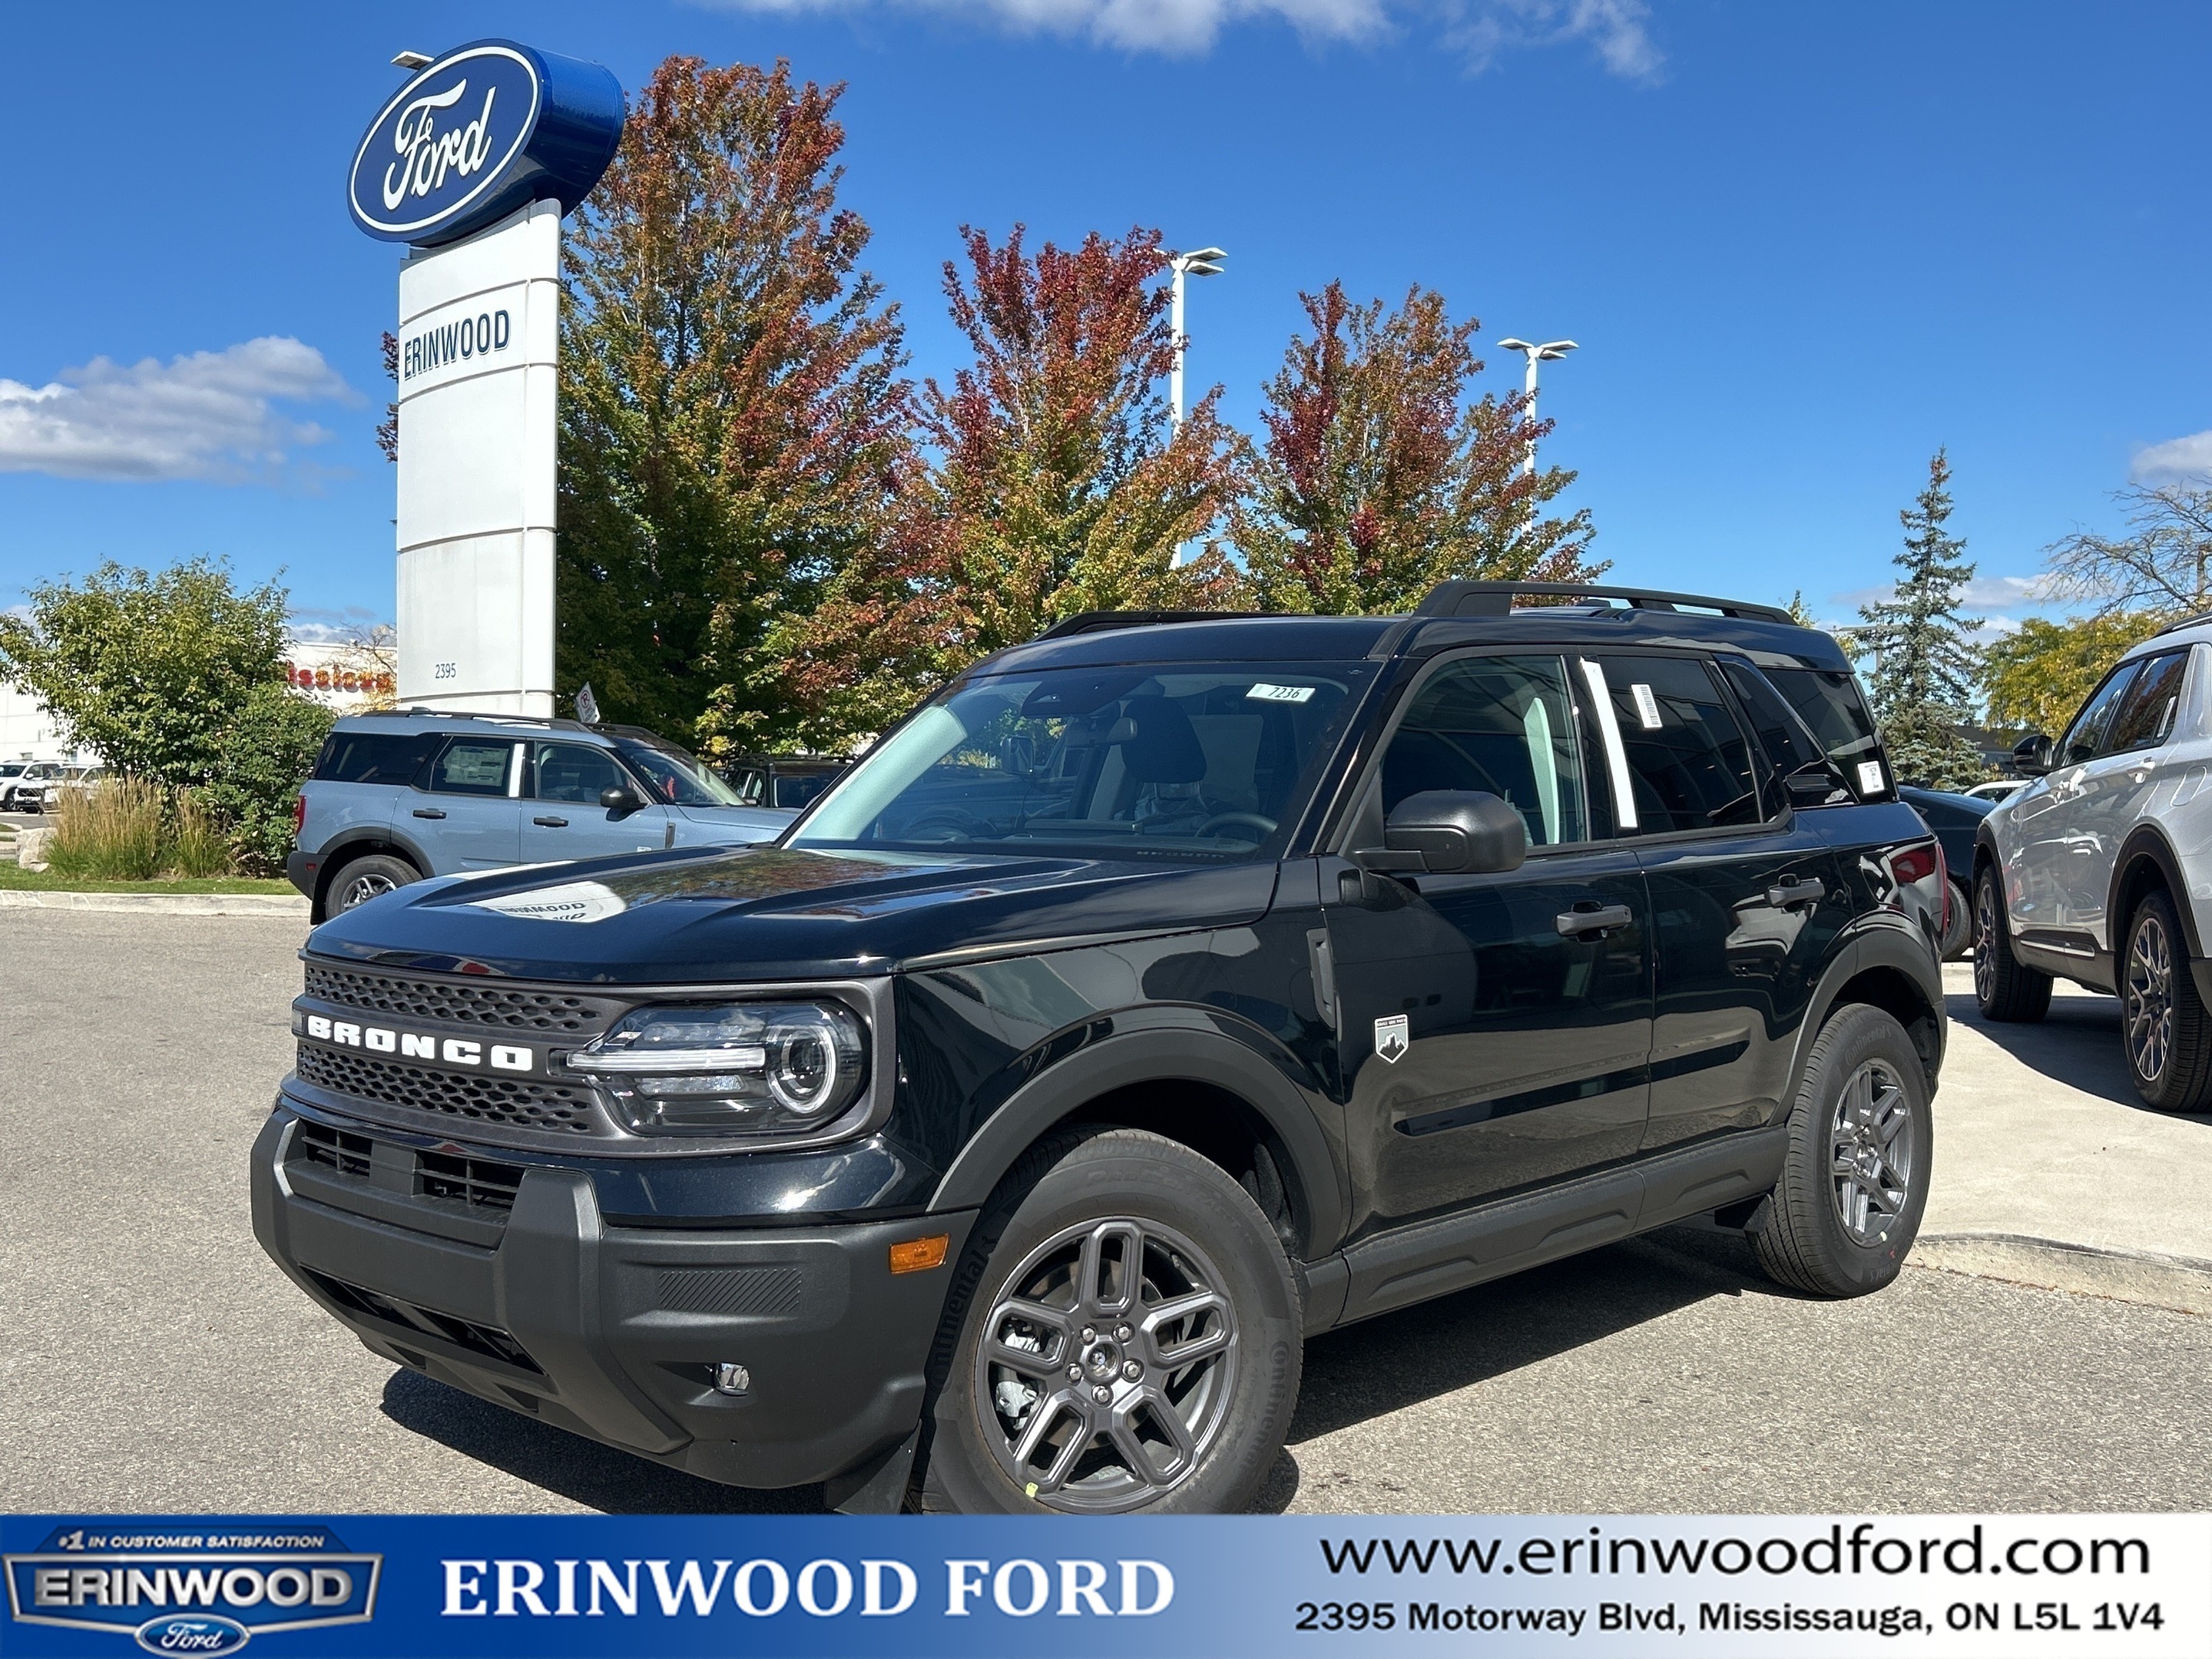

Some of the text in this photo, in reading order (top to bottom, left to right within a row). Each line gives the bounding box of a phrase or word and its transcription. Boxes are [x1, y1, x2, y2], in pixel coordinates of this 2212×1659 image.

[383, 78, 497, 210] Ford
[405, 309, 510, 379] ERINWOOD
[435, 662, 456, 679] 2395
[1268, 687, 1303, 698] 7236
[307, 1015, 534, 1071] BRONCO
